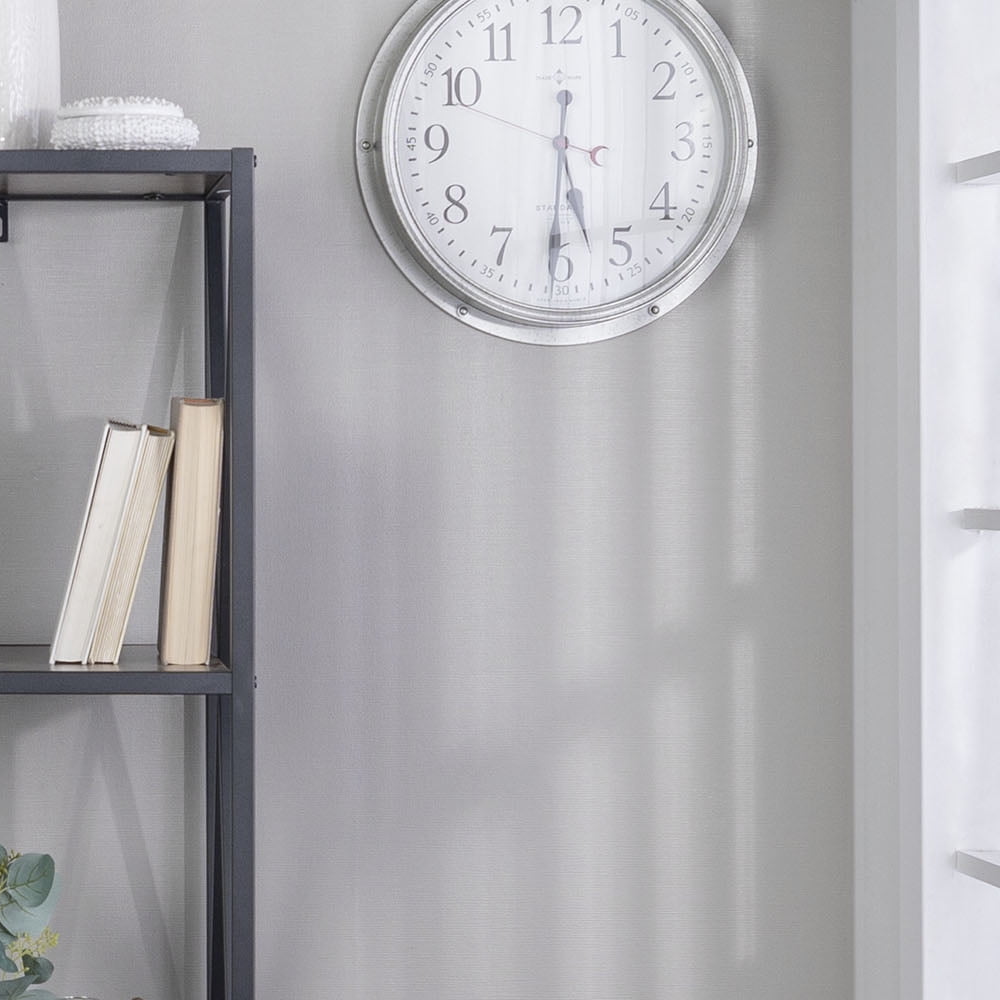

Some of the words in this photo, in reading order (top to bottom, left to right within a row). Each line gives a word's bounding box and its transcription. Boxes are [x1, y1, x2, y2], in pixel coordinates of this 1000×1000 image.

[476, 8, 492, 23] 55
[540, 5, 583, 45] 12
[624, 7, 640, 21] 05
[483, 22, 517, 62] 11
[609, 19, 627, 58] 1
[424, 62, 438, 78] 50
[441, 66, 482, 107] 10
[652, 61, 676, 100] 2
[681, 62, 694, 76] 10
[406, 136, 416, 151] 45
[424, 124, 450, 164] 9
[671, 121, 696, 161] 3
[702, 136, 712, 149] 15
[426, 212, 439, 226] 40
[443, 184, 468, 224] 8
[649, 182, 678, 220] 4
[681, 207, 696, 223] 20
[490, 225, 513, 266] 7
[548, 242, 574, 283] 6
[609, 224, 632, 267] 5
[480, 264, 496, 279] 35
[626, 262, 642, 278] 25
[554, 285, 570, 296] 30
